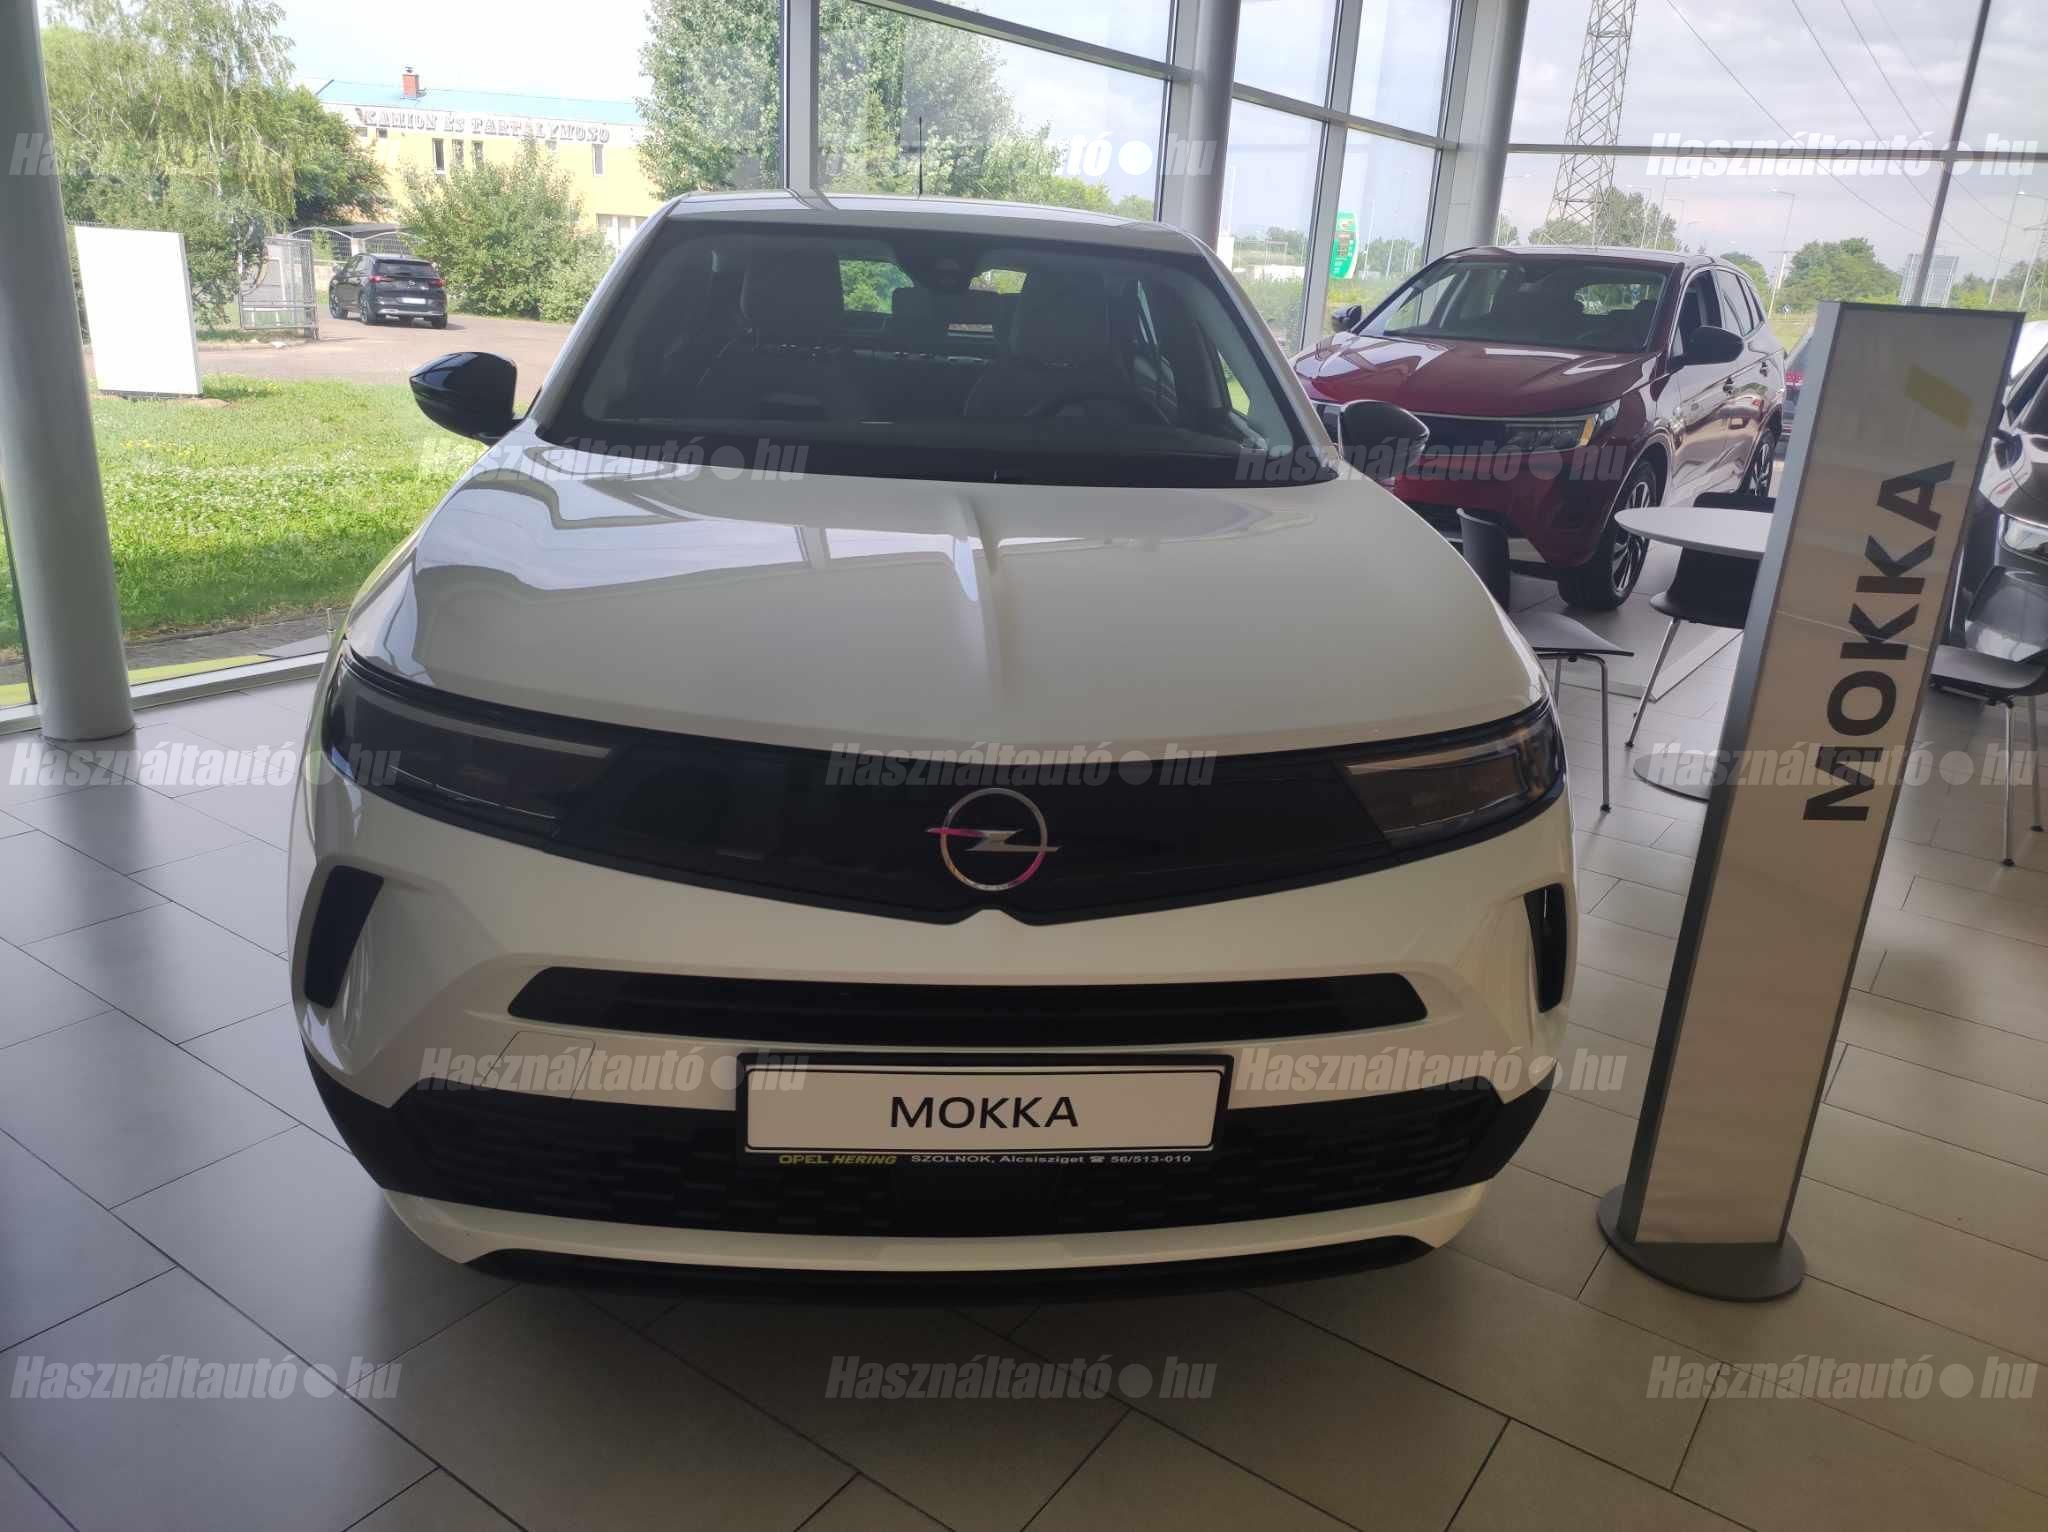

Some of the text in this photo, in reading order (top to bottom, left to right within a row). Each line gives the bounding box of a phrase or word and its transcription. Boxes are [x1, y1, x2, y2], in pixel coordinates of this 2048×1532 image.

[1803, 461, 1954, 822] MOKKA
[889, 1096, 1079, 1129] MOKKA
[779, 1154, 1192, 1165] OPEL HERING SZOLNOK, Alcsisziget 56/513-010
